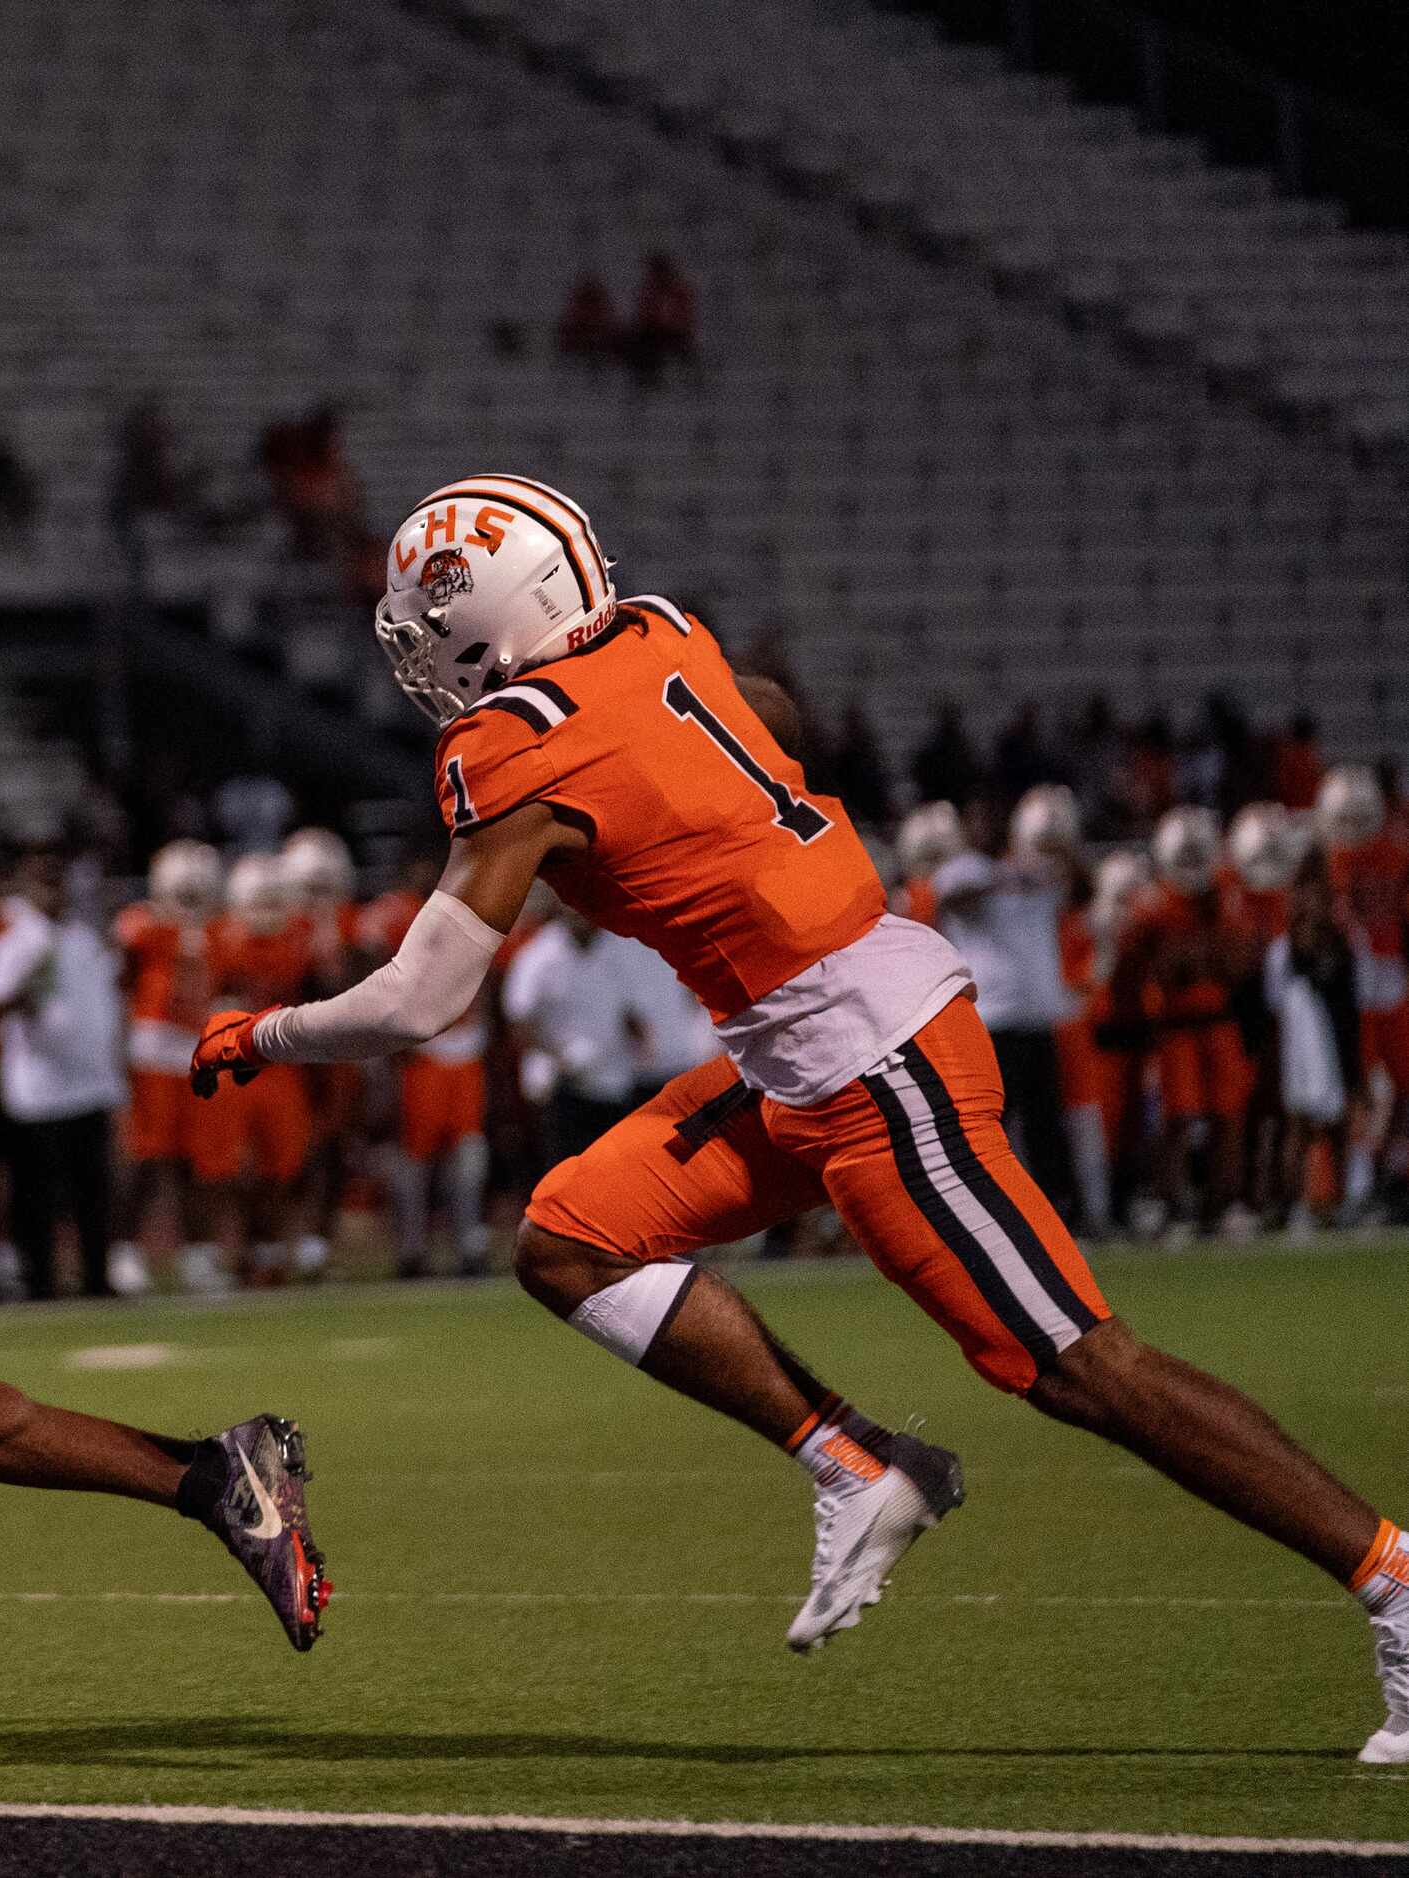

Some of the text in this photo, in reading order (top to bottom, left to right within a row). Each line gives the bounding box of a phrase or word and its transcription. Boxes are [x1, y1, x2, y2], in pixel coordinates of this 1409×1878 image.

[394, 504, 515, 573] LHS
[566, 601, 616, 651] Ridd
[446, 754, 480, 828] 1
[662, 671, 835, 845] 1
